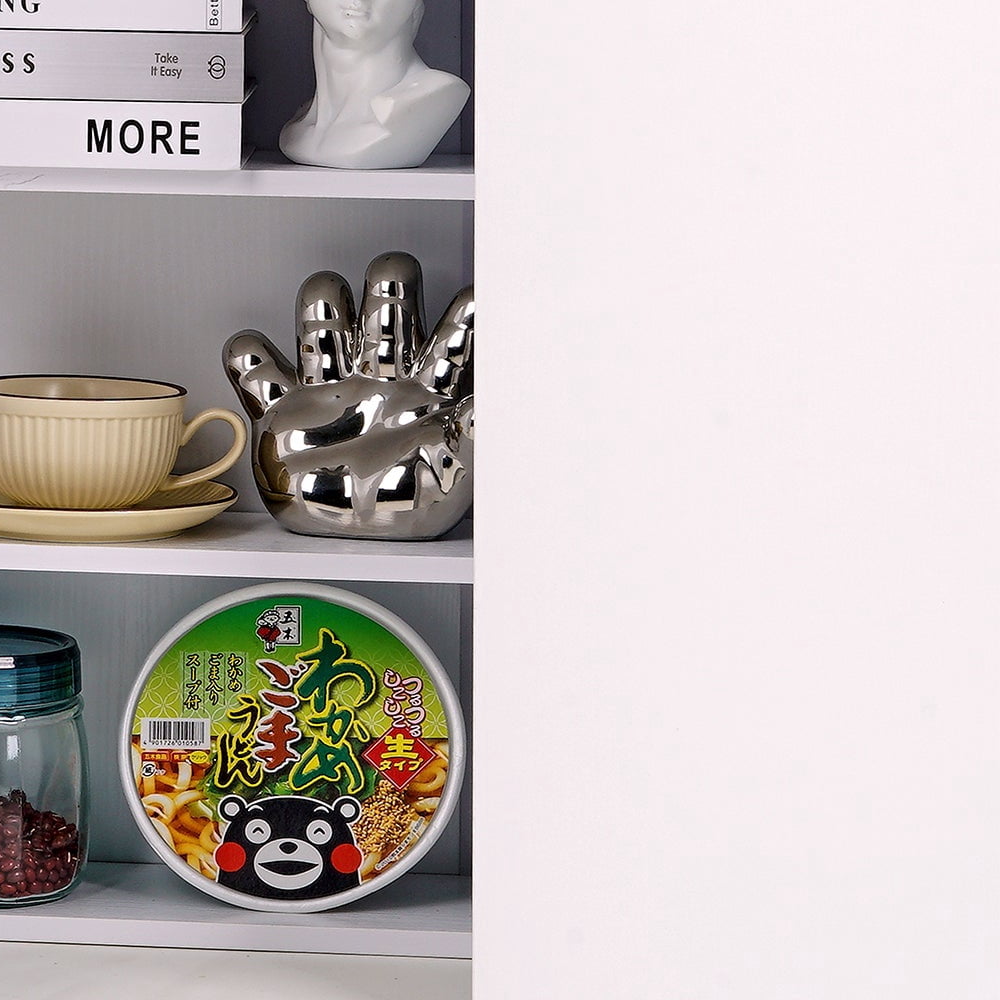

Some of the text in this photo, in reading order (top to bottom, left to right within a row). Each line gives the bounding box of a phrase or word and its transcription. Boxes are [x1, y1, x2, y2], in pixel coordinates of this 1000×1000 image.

[151, 66, 182, 79] It Easy
[154, 53, 178, 64] Take
[87, 118, 200, 155] MORE
[183, 654, 202, 710] スープ付
[206, 653, 224, 705] ごま入り
[227, 653, 243, 692] わかめ
[253, 659, 307, 772] ごま
[289, 628, 376, 794] わかめ
[402, 677, 426, 738] つるつる
[380, 733, 419, 759] 生
[380, 758, 423, 771] タイプ
